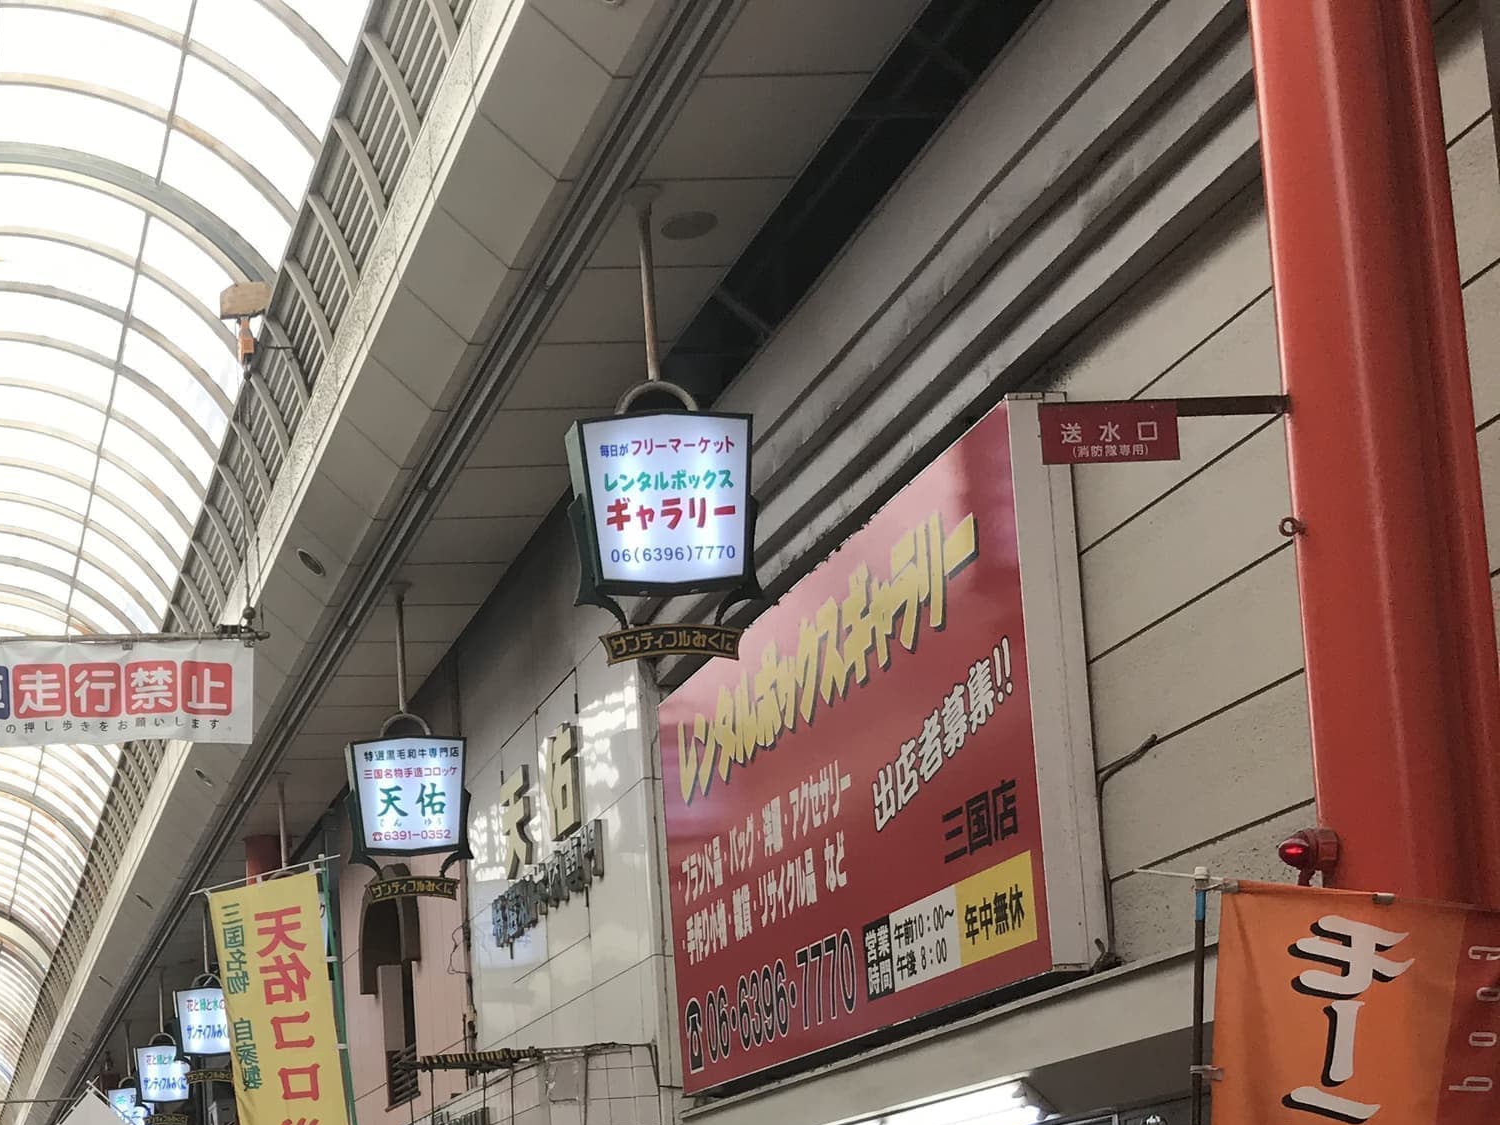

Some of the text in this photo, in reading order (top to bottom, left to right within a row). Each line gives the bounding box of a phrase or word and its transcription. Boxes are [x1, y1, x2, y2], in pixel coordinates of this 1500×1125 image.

[600, 436, 735, 458] 毎日がフリーマーケット
[1060, 421, 1158, 444] 送水口
[604, 469, 735, 492] レンタルボックス
[606, 497, 736, 532] ギャラリー
[610, 545, 736, 563] 06(6396)7770
[611, 630, 736, 654] サンティフルみくに
[678, 510, 978, 805] レンタルボックスギャラリー
[377, 782, 447, 817] 天佑
[383, 829, 452, 841] 6391-0352
[941, 780, 1018, 864] 三国店
[963, 884, 1025, 946] 年中無休
[864, 924, 891, 963] 営業
[867, 956, 894, 995] 時間
[895, 949, 917, 982] 午後
[186, 1023, 229, 1040] サンティフルみく
